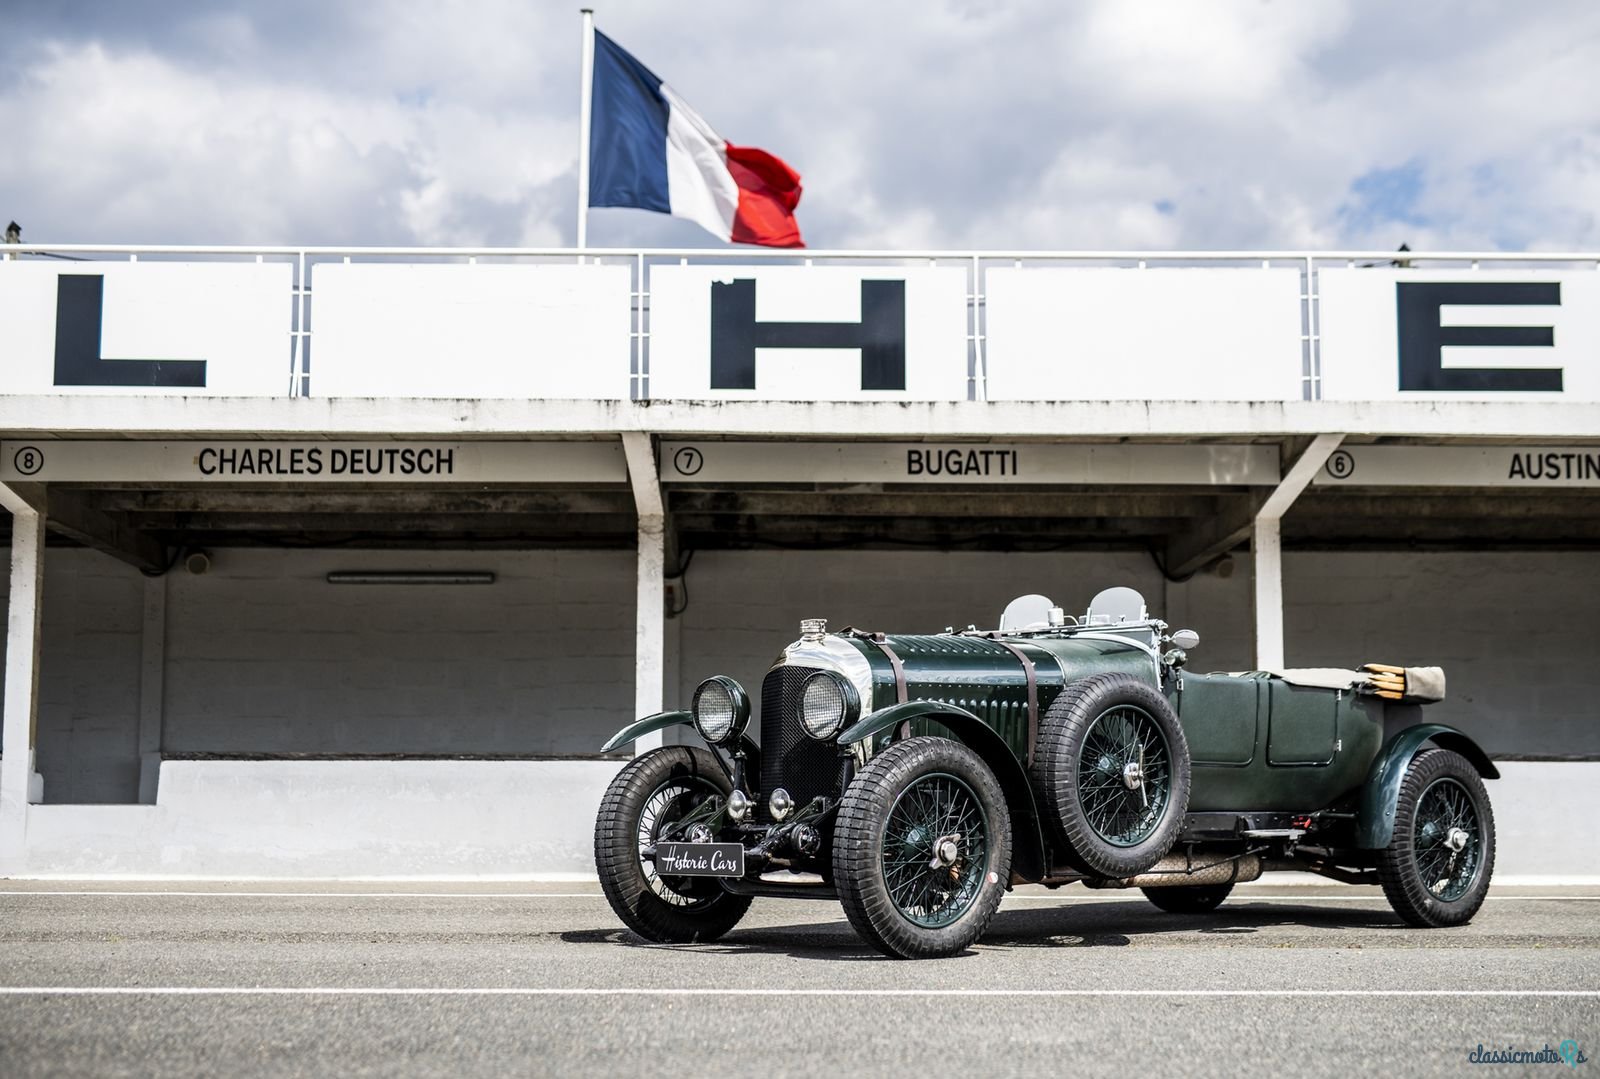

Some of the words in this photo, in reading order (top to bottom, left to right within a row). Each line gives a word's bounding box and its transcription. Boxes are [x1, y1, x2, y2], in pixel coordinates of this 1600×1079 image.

[53, 274, 207, 387] L
[710, 278, 906, 391] H
[1396, 281, 1563, 392] E
[24, 452, 34, 469] 8
[198, 447, 323, 475] CHARLES
[330, 448, 454, 475] DEUTSCH
[683, 452, 694, 469] 7
[907, 449, 1018, 476] BUGATTI
[1335, 455, 1345, 474] 6
[1508, 453, 1600, 480] AUSTIN
[661, 845, 708, 872] Historic
[710, 850, 737, 872] Cars
